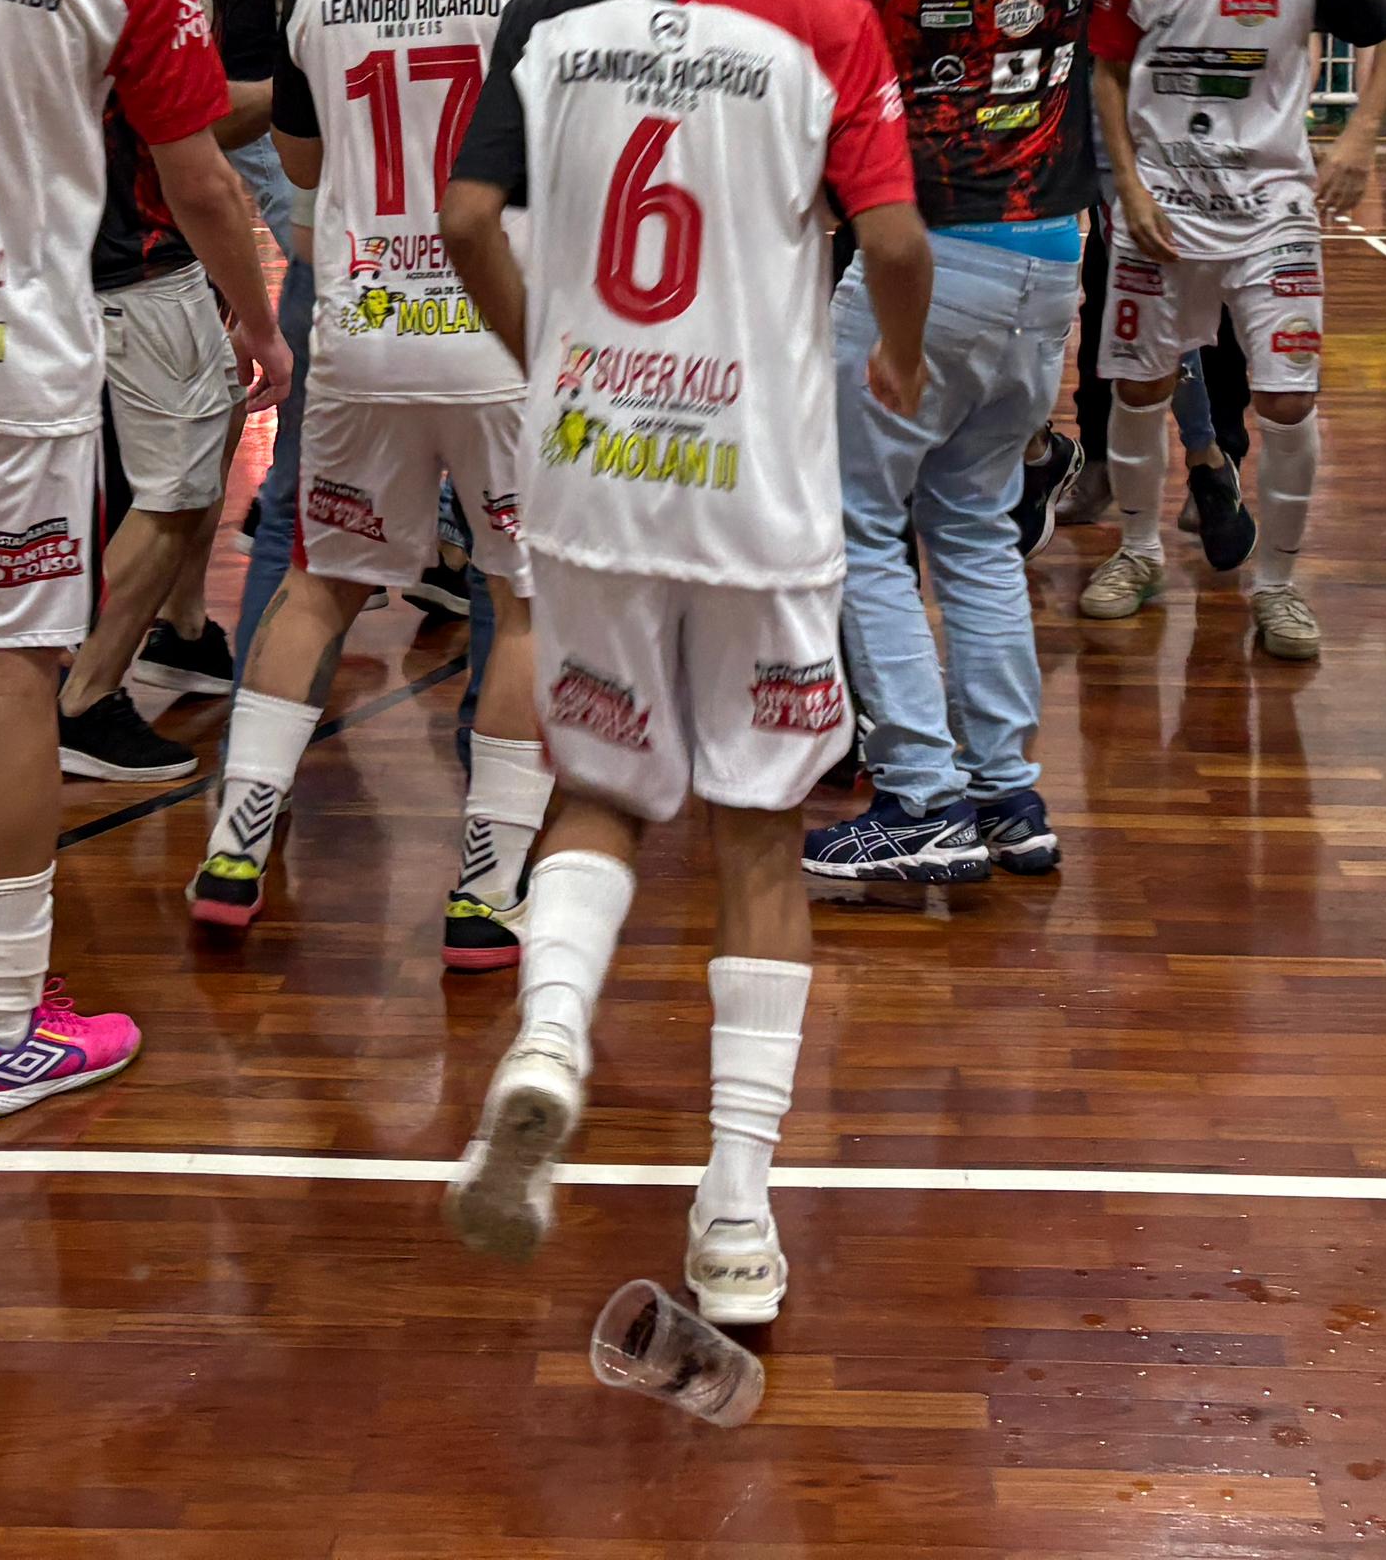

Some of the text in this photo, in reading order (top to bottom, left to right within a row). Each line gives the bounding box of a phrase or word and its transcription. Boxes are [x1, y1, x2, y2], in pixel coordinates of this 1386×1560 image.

[376, 20, 443, 39] IMÓVEIS
[345, 44, 482, 216] 17
[594, 116, 703, 325] 6
[1116, 299, 1139, 341] 8
[680, 354, 743, 407] KILO
[592, 429, 710, 487] MOLAN
[13, 554, 78, 580] POUSO
